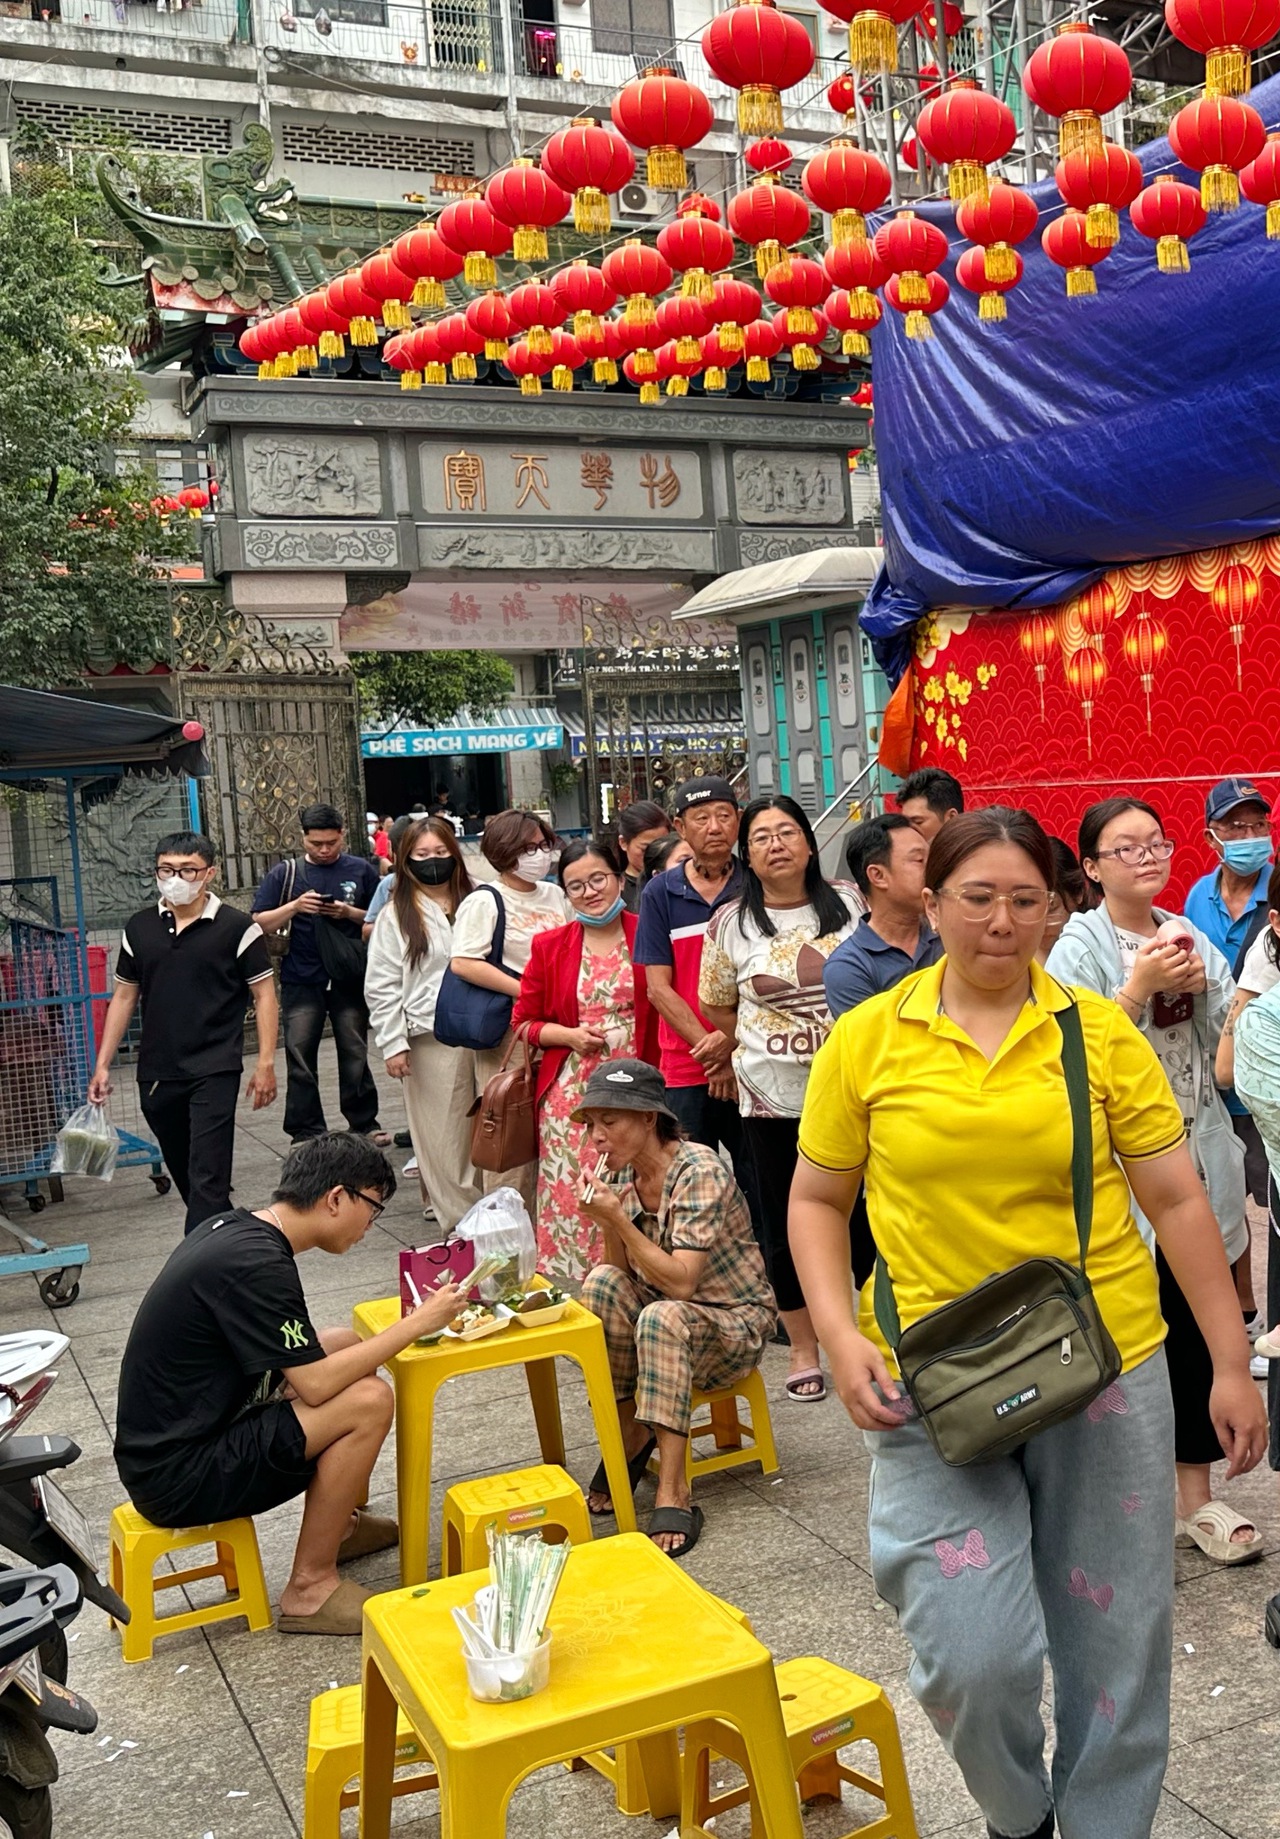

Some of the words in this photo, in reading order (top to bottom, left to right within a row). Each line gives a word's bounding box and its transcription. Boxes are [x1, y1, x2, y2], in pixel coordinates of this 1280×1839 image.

[369, 735, 407, 754] PHÊ
[412, 736, 463, 755] SẠCH
[467, 733, 528, 750] MANG
[685, 789, 712, 802] Turner
[766, 1025, 832, 1056] adi
[1020, 1388, 1037, 1404] ARMY
